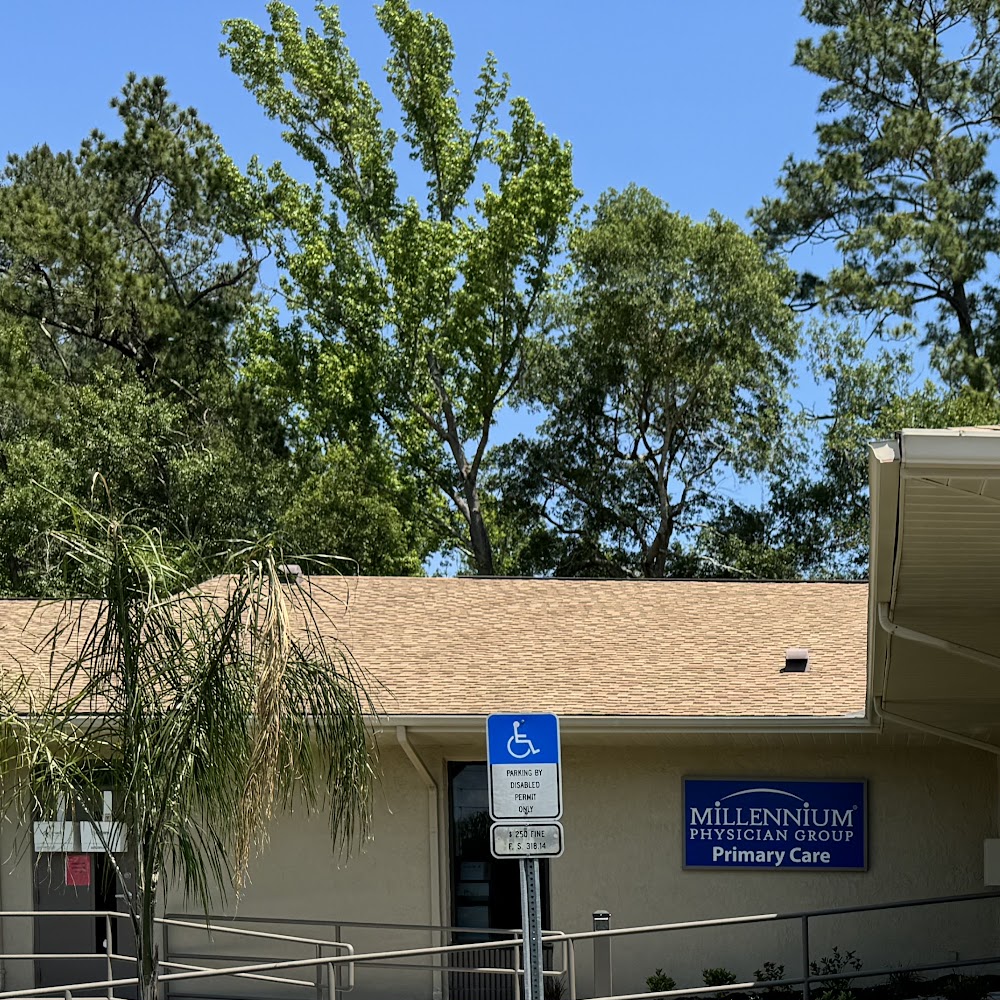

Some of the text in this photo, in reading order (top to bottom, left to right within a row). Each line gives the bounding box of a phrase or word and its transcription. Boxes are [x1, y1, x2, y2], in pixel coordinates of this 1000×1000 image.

[689, 801, 854, 827] MILLENNIUM
[689, 828, 854, 842] PHYSICIAN GROUP
[712, 846, 831, 867] Primary Care
